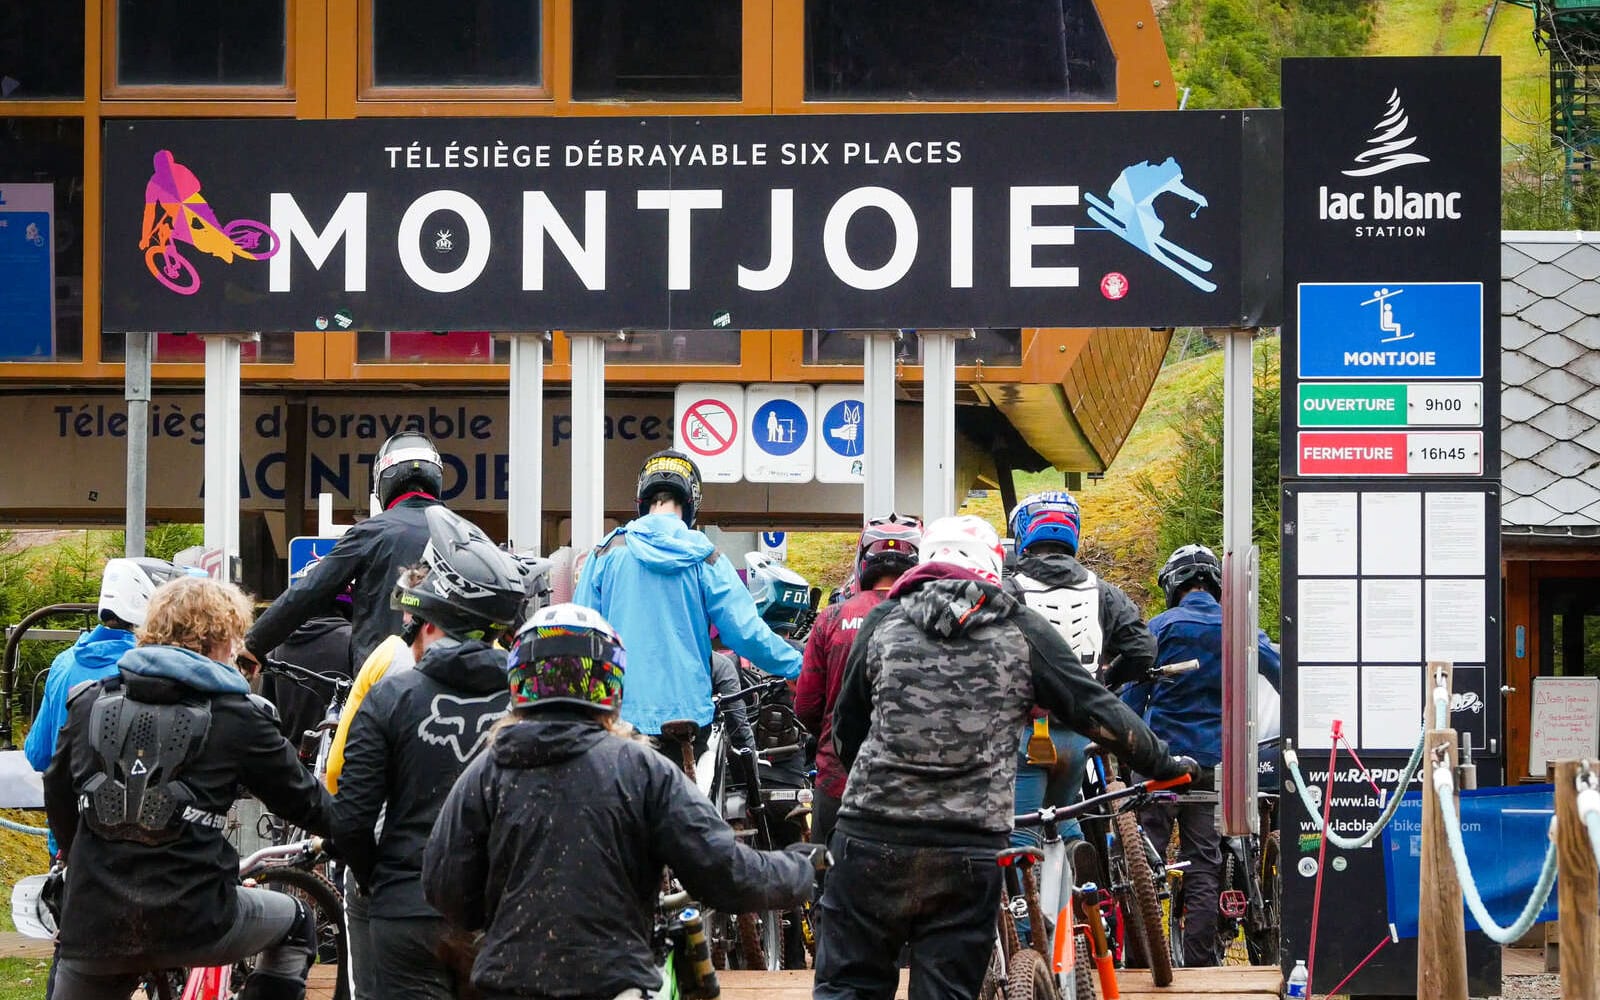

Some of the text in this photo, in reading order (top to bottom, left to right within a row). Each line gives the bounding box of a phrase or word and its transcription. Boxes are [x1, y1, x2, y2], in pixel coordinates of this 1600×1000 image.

[384, 139, 962, 168] TÉLÉSIÈGE DÉBRAYABLE SIX PLACES
[1319, 185, 1462, 220] lac blanc
[268, 184, 1080, 294] MONTJOIE
[1355, 226, 1426, 238] STATION
[1344, 351, 1436, 366] MONTJOIE
[1303, 398, 1462, 412] OUVERTURE 9h00
[255, 405, 493, 440] dbrayable
[1303, 447, 1466, 461] FERMETURE 16h45
[782, 590, 810, 605] FOX
